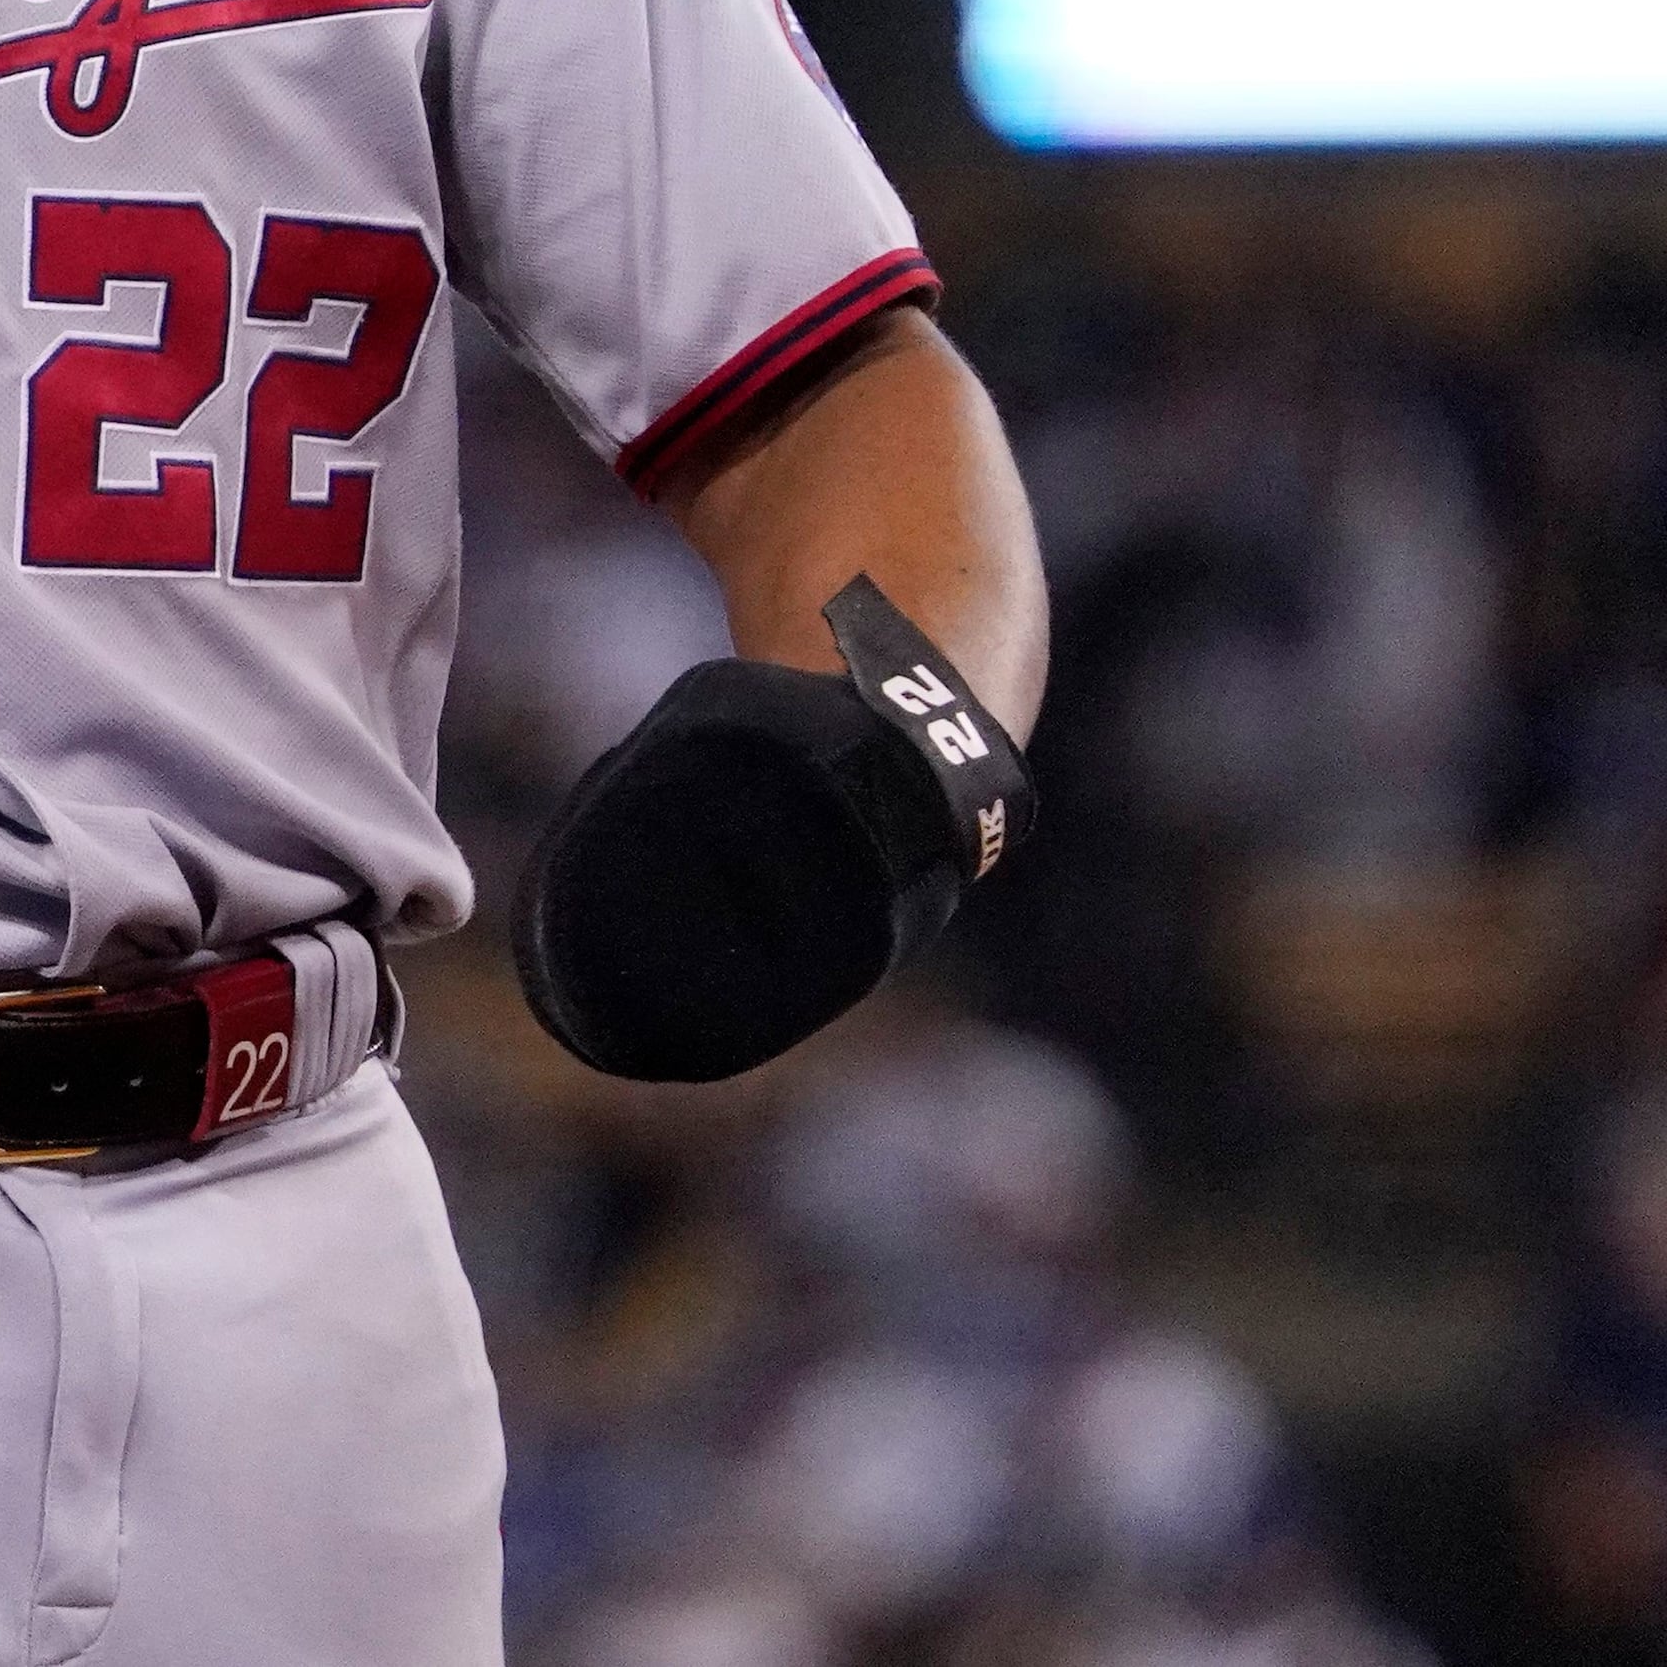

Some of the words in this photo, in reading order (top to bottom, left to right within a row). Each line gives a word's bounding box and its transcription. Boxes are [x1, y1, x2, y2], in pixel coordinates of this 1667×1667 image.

[17, 188, 447, 585] 22
[880, 663, 990, 766] 22
[219, 1032, 289, 1122] 22
